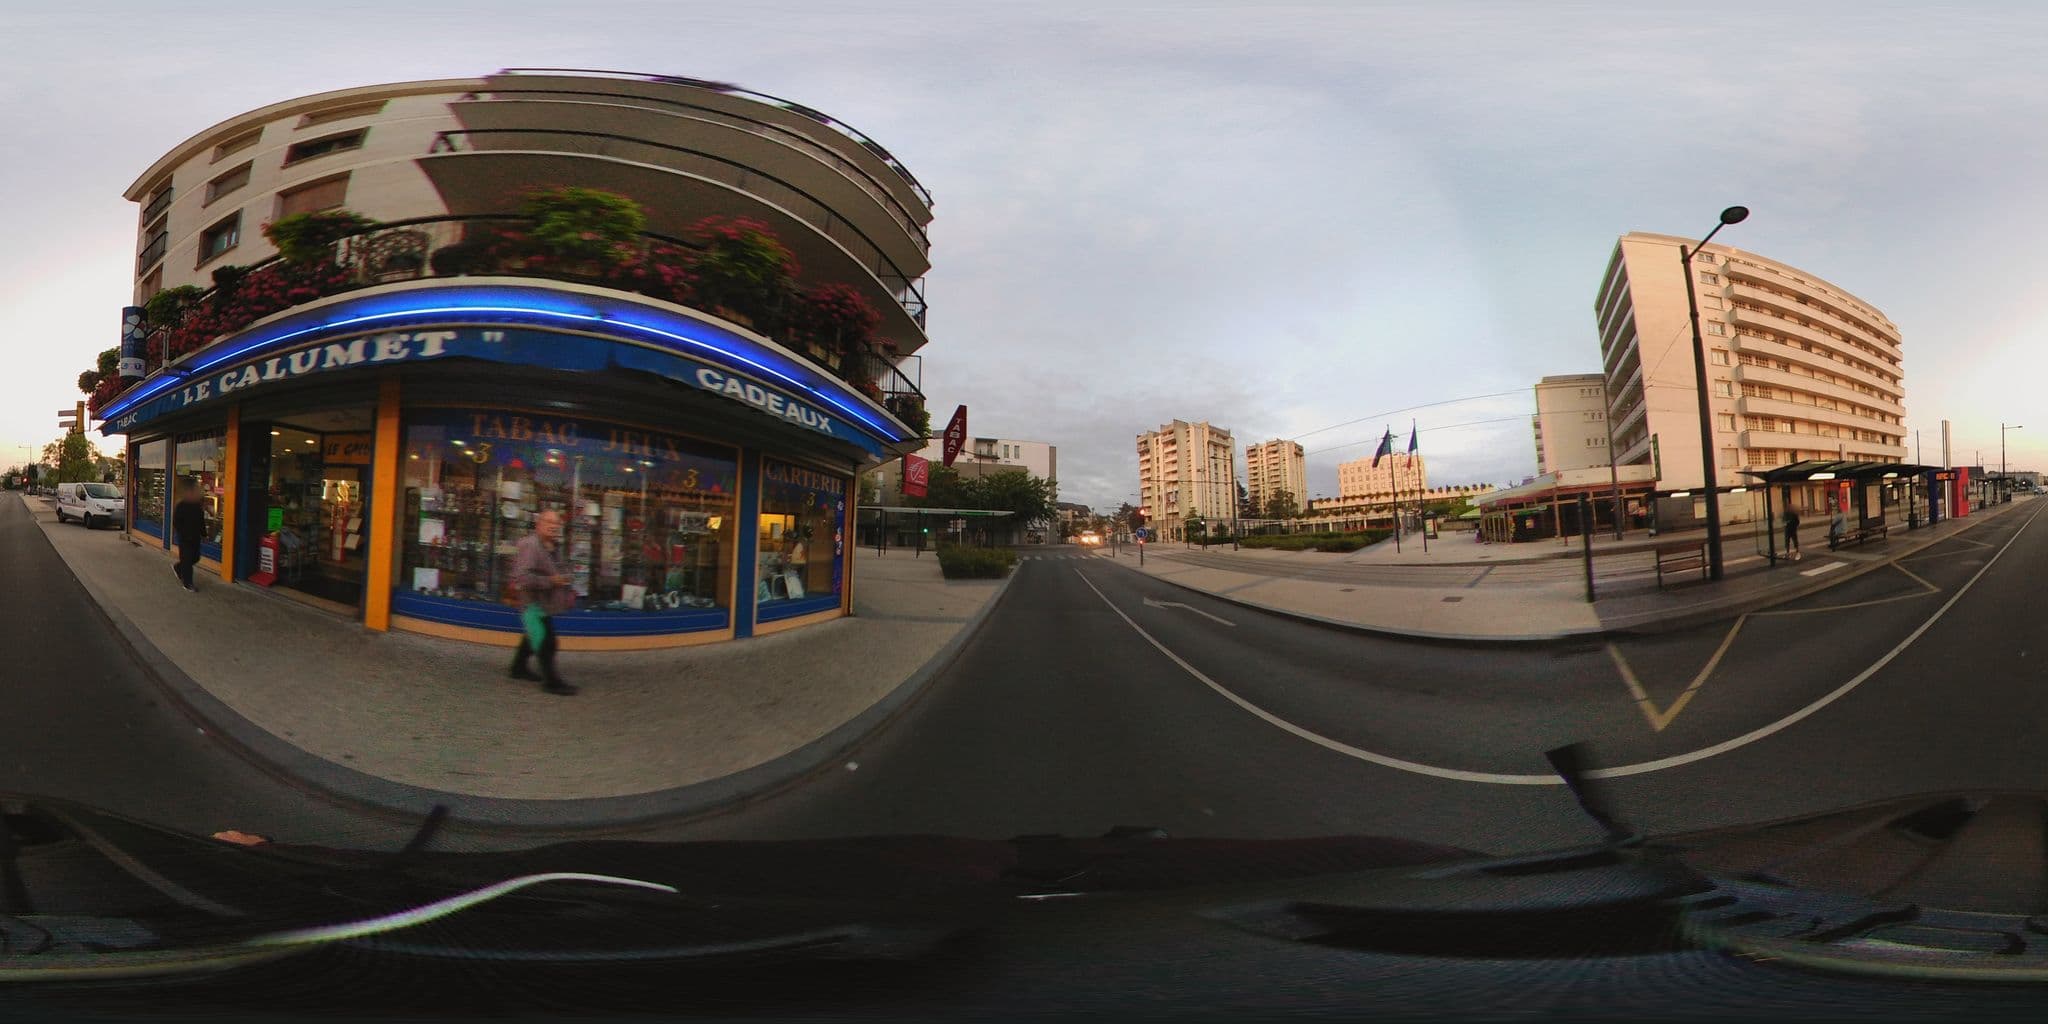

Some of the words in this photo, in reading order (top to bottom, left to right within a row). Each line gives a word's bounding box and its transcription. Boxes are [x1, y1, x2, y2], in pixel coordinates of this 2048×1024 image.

[182, 381, 210, 405] LE
[219, 331, 457, 393] CALUMET
[116, 412, 138, 430] TABAC
[696, 368, 833, 433] CADEAUX
[470, 412, 578, 446] TABAC
[602, 428, 681, 462] JEUX
[948, 418, 962, 453] TABAC
